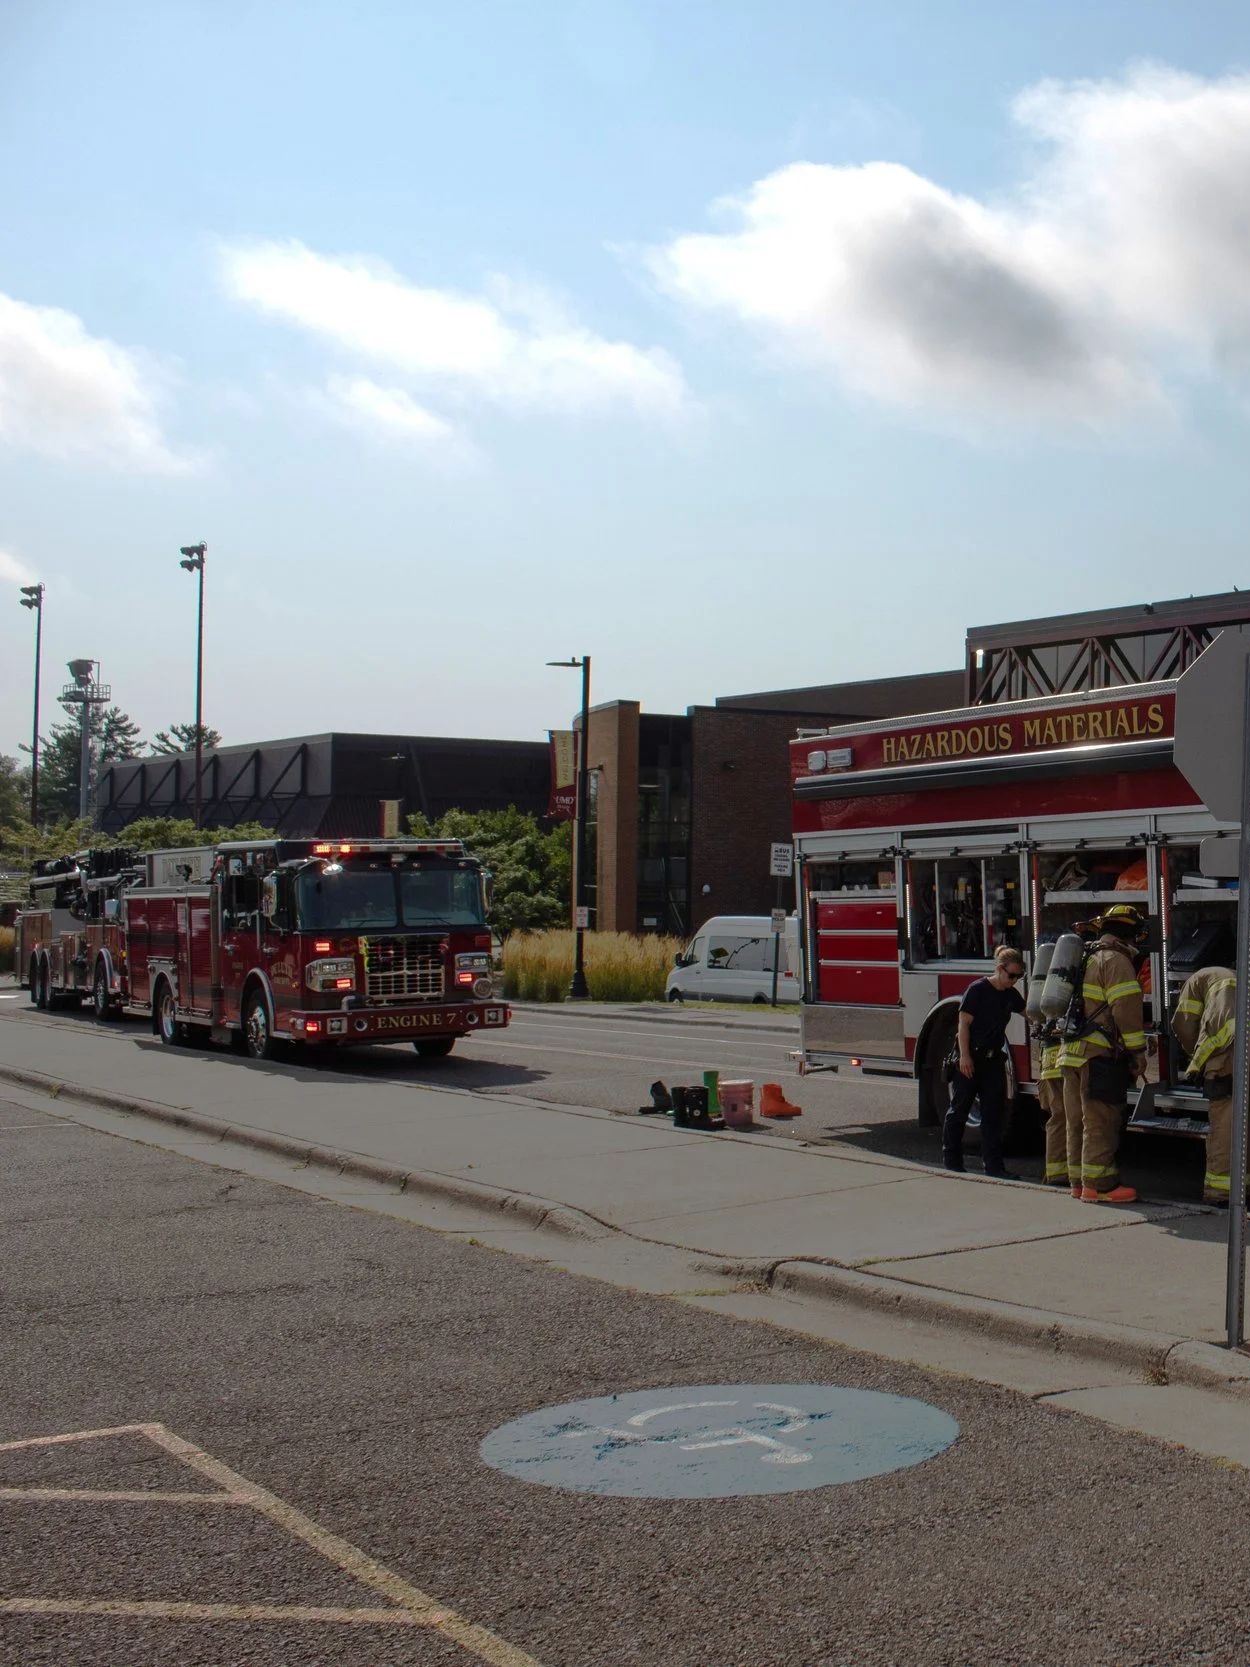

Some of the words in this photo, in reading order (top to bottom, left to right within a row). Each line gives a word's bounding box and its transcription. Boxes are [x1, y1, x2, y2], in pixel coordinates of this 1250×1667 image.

[882, 722, 1012, 763] HAZARDOUS
[1023, 704, 1165, 747] MATERIALS
[554, 796, 575, 805] UMD
[376, 1014, 442, 1029] ENGINE
[446, 1013, 457, 1025] 7
